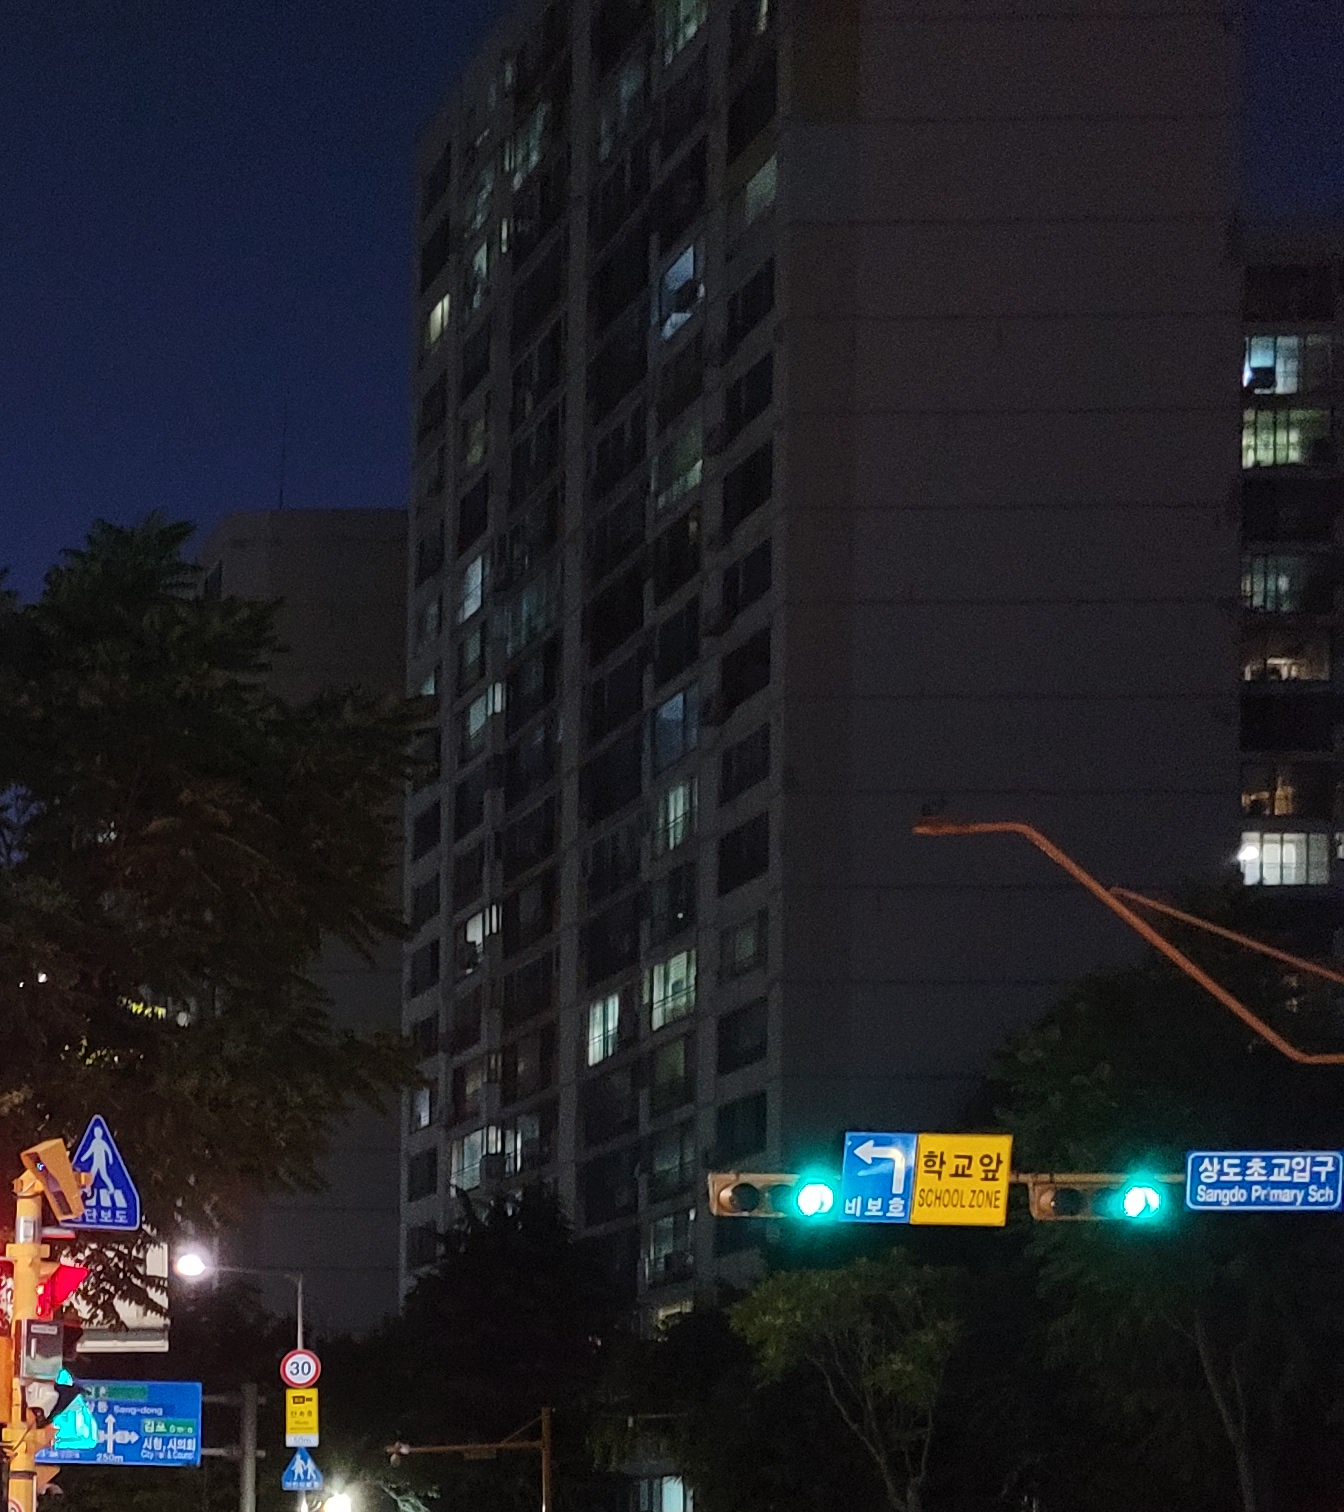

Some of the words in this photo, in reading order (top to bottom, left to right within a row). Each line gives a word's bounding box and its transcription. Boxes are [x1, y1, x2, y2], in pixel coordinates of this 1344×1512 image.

[923, 1151, 1004, 1182] 학교앞
[1198, 1156, 1336, 1183] 상도초교입구
[917, 1188, 966, 1209] SCHOOL
[968, 1189, 1002, 1209] ZONE
[1196, 1185, 1248, 1206] Sangdo
[1251, 1185, 1305, 1206] Primary
[1307, 1185, 1334, 1203] Sch
[73, 1208, 129, 1223] 단보도
[844, 1195, 905, 1218] 비보호
[289, 1361, 311, 1376] 30
[113, 1405, 163, 1416] Sang-dong
